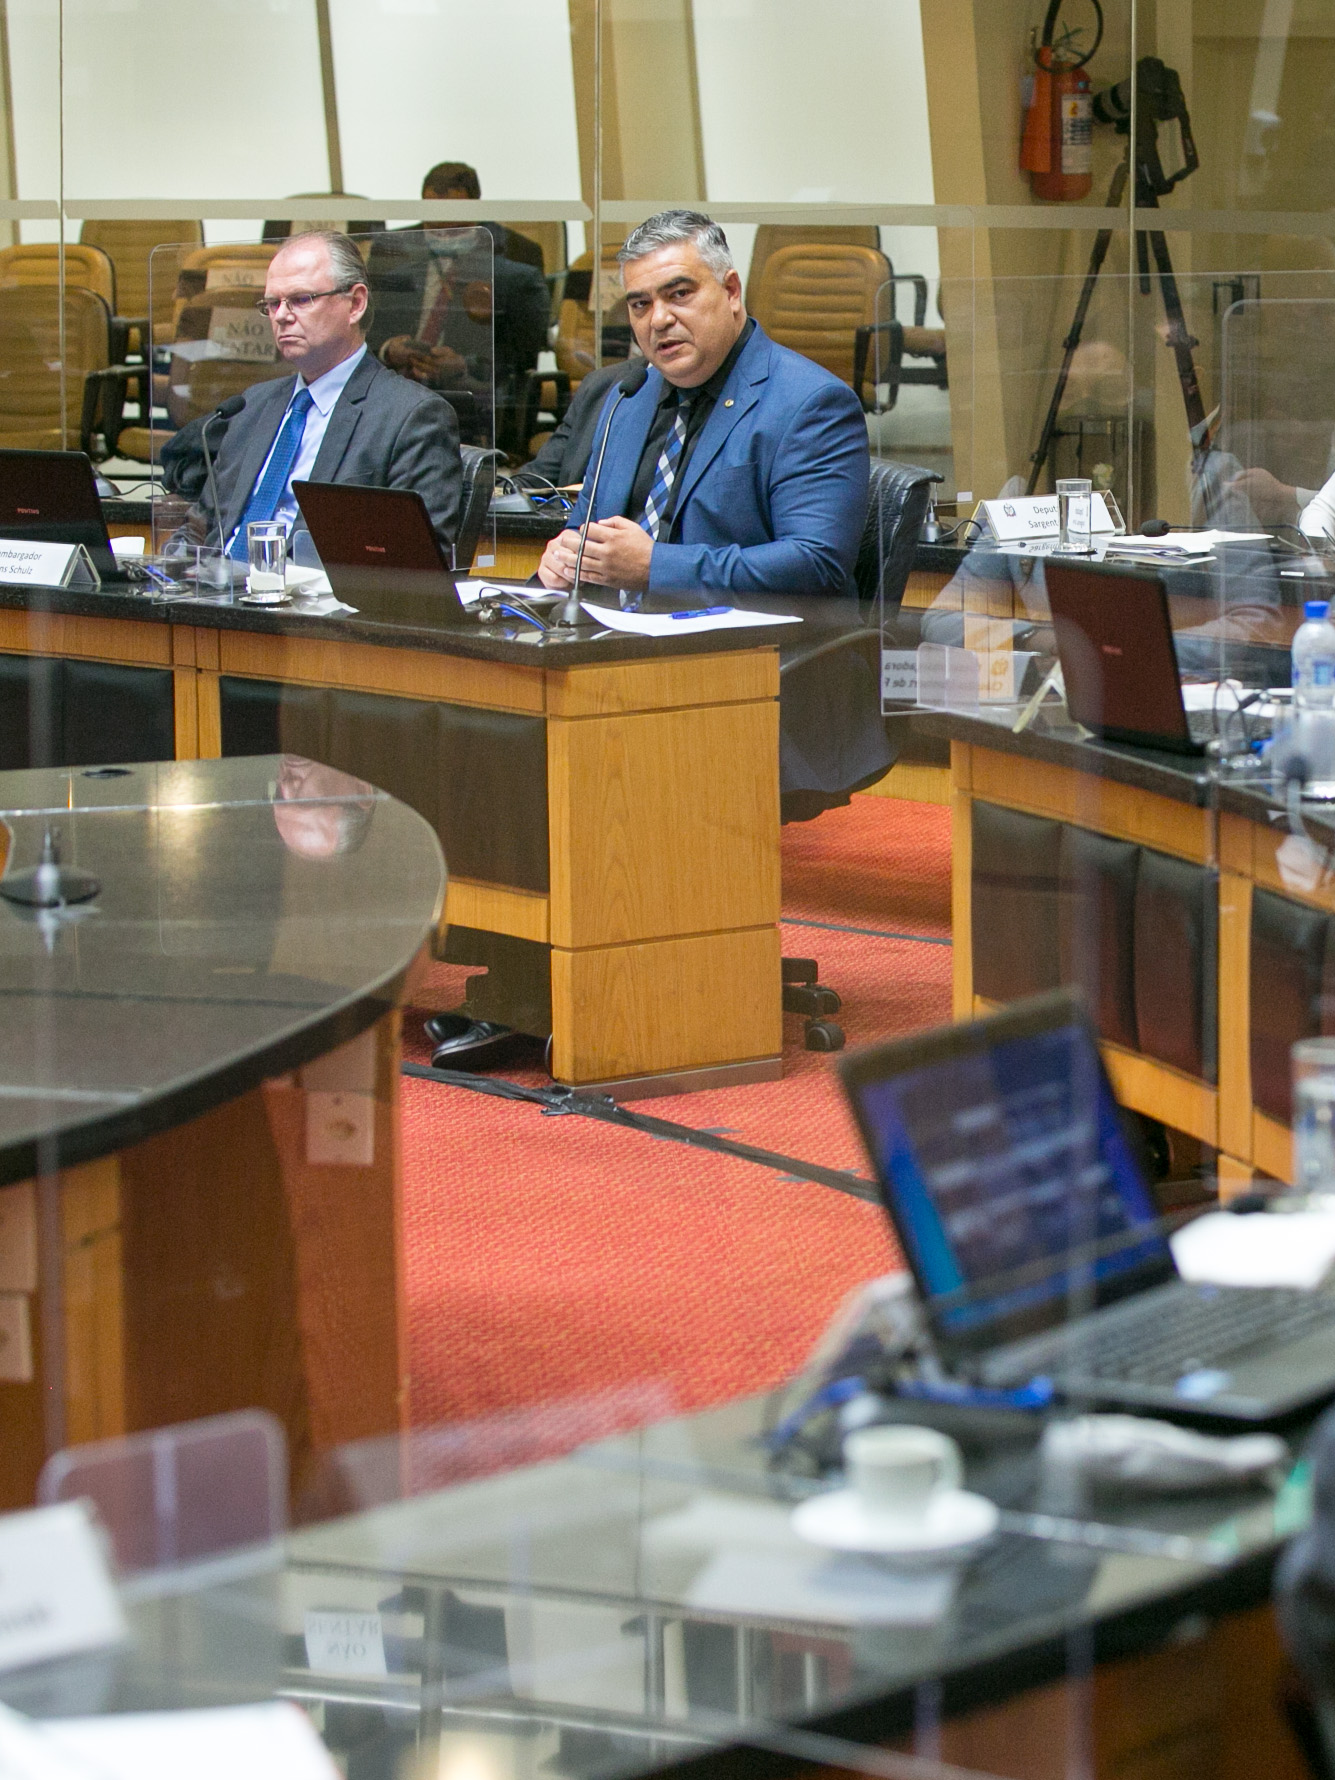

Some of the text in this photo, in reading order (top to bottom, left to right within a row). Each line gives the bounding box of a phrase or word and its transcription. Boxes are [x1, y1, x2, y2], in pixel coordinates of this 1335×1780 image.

[1033, 505, 1058, 515] Deput
[1028, 519, 1059, 530] Sargent
[0, 550, 42, 561] mbargador
[9, 565, 33, 575] Schulz
